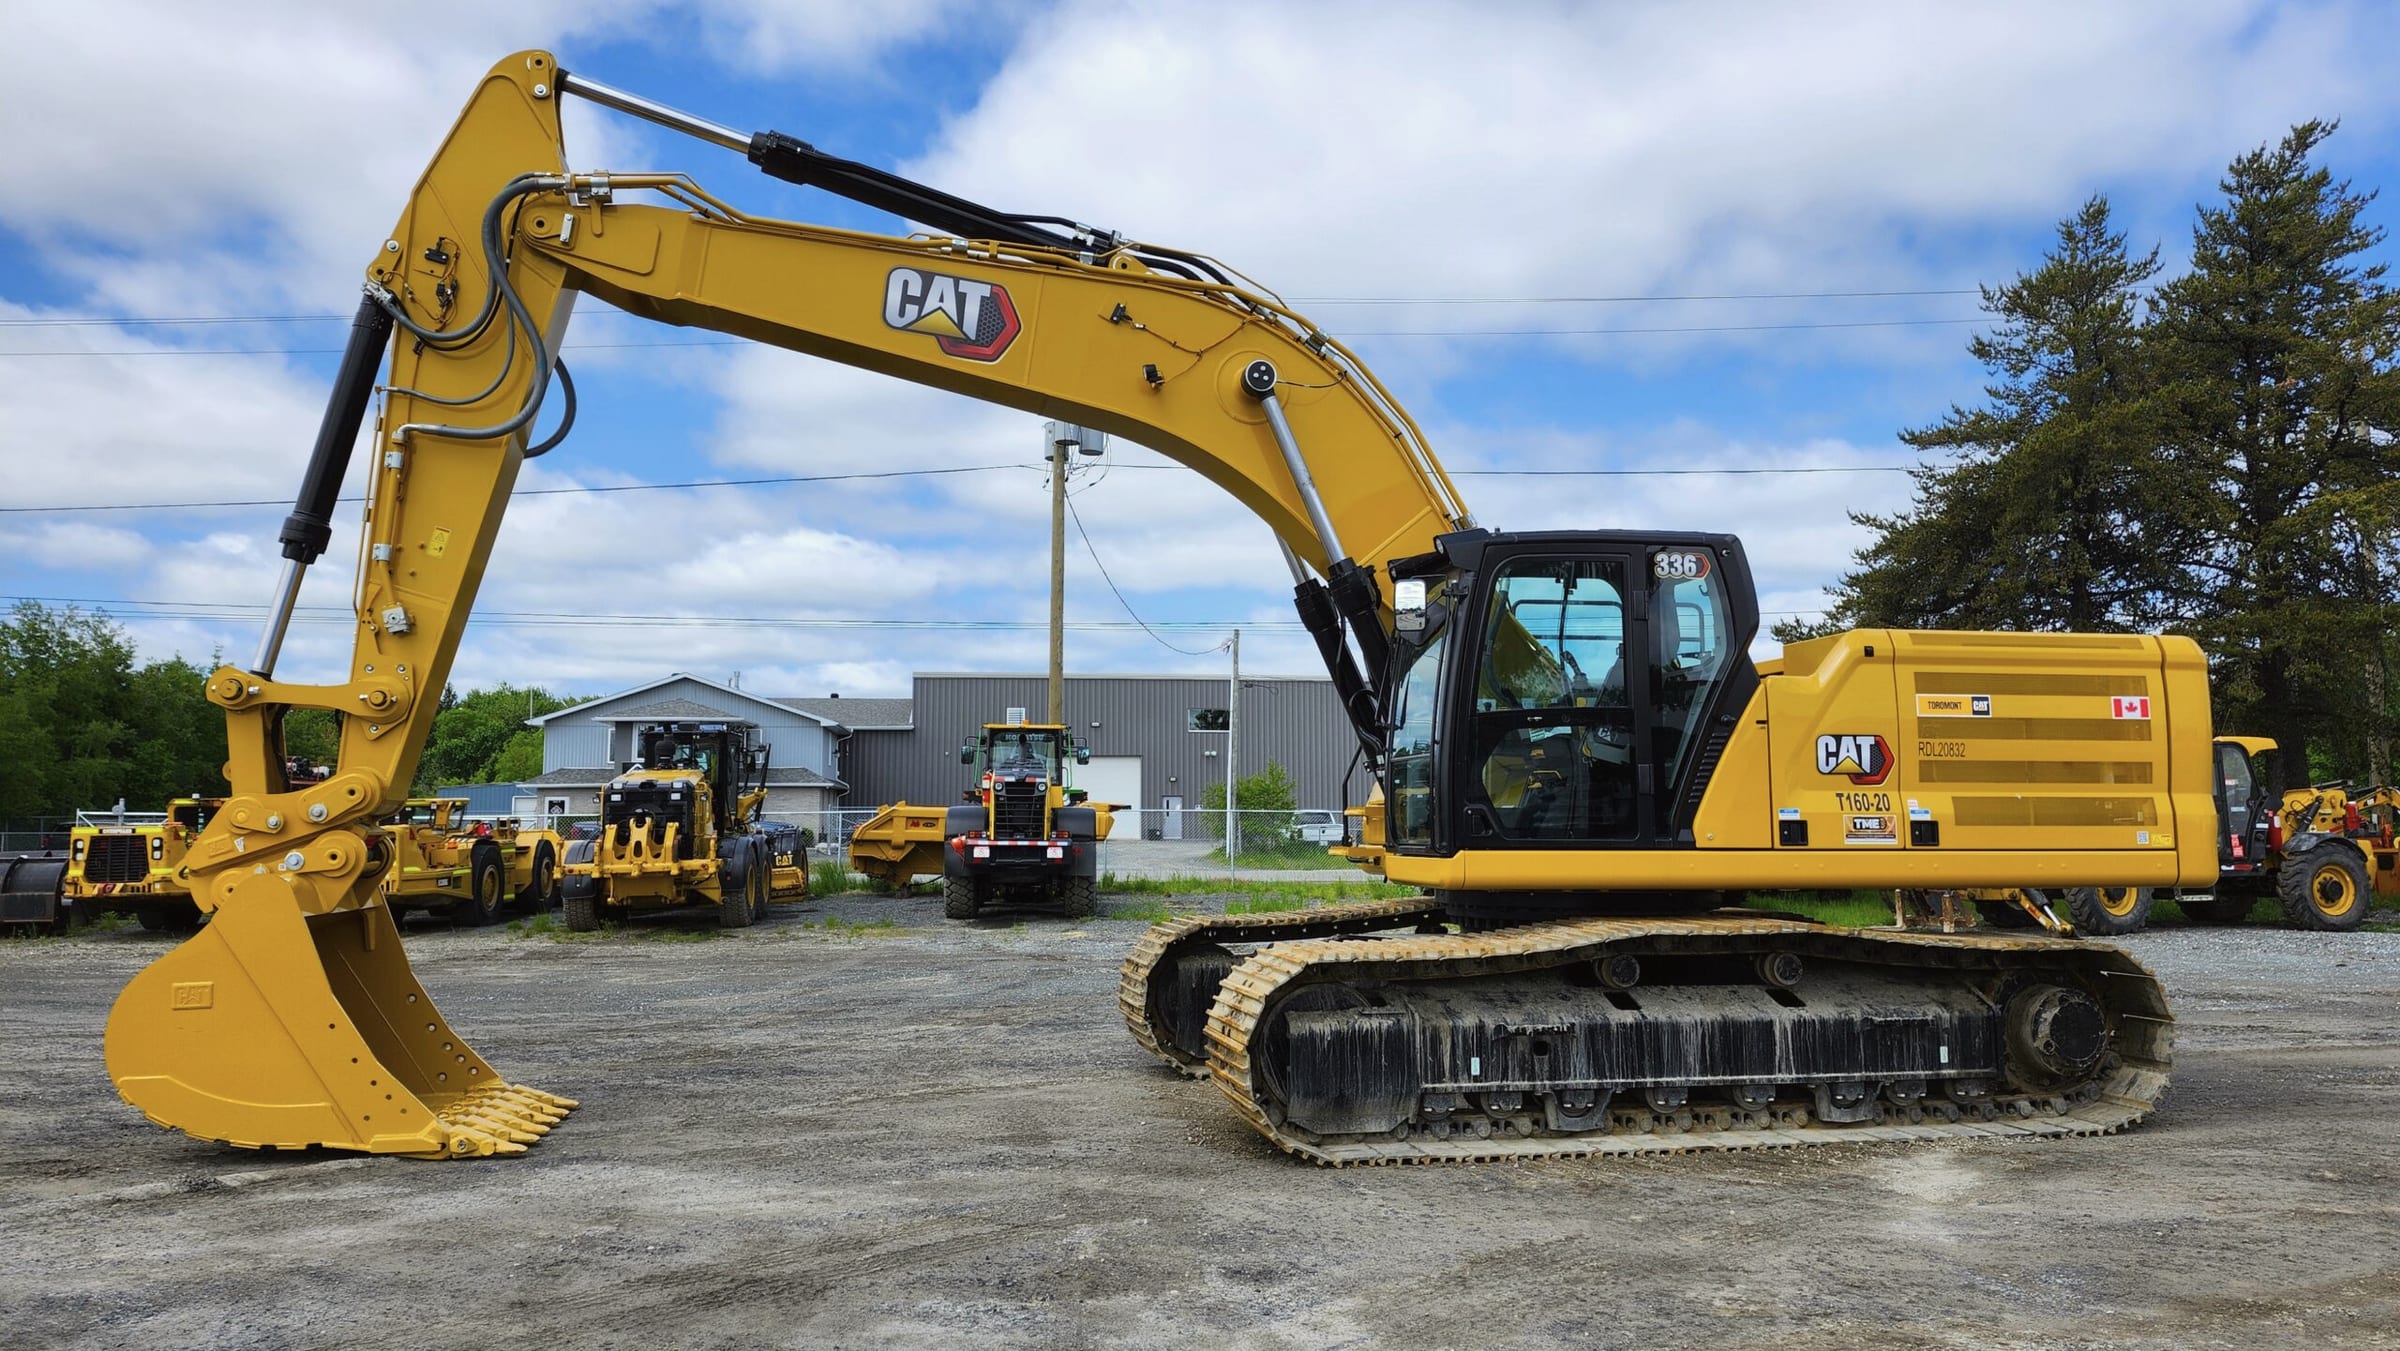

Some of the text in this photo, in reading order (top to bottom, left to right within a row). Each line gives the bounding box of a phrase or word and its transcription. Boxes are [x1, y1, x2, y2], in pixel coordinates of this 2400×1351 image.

[885, 268, 991, 341] CAT
[1656, 553, 1696, 577] 336
[1927, 700, 1989, 712] TOROMONT CAT
[1817, 735, 1875, 773] CAT
[1918, 741, 1966, 757] RDL20832
[1835, 792, 1891, 811] T160-20
[1853, 818, 1880, 829] TME
[775, 854, 793, 867] CAT
